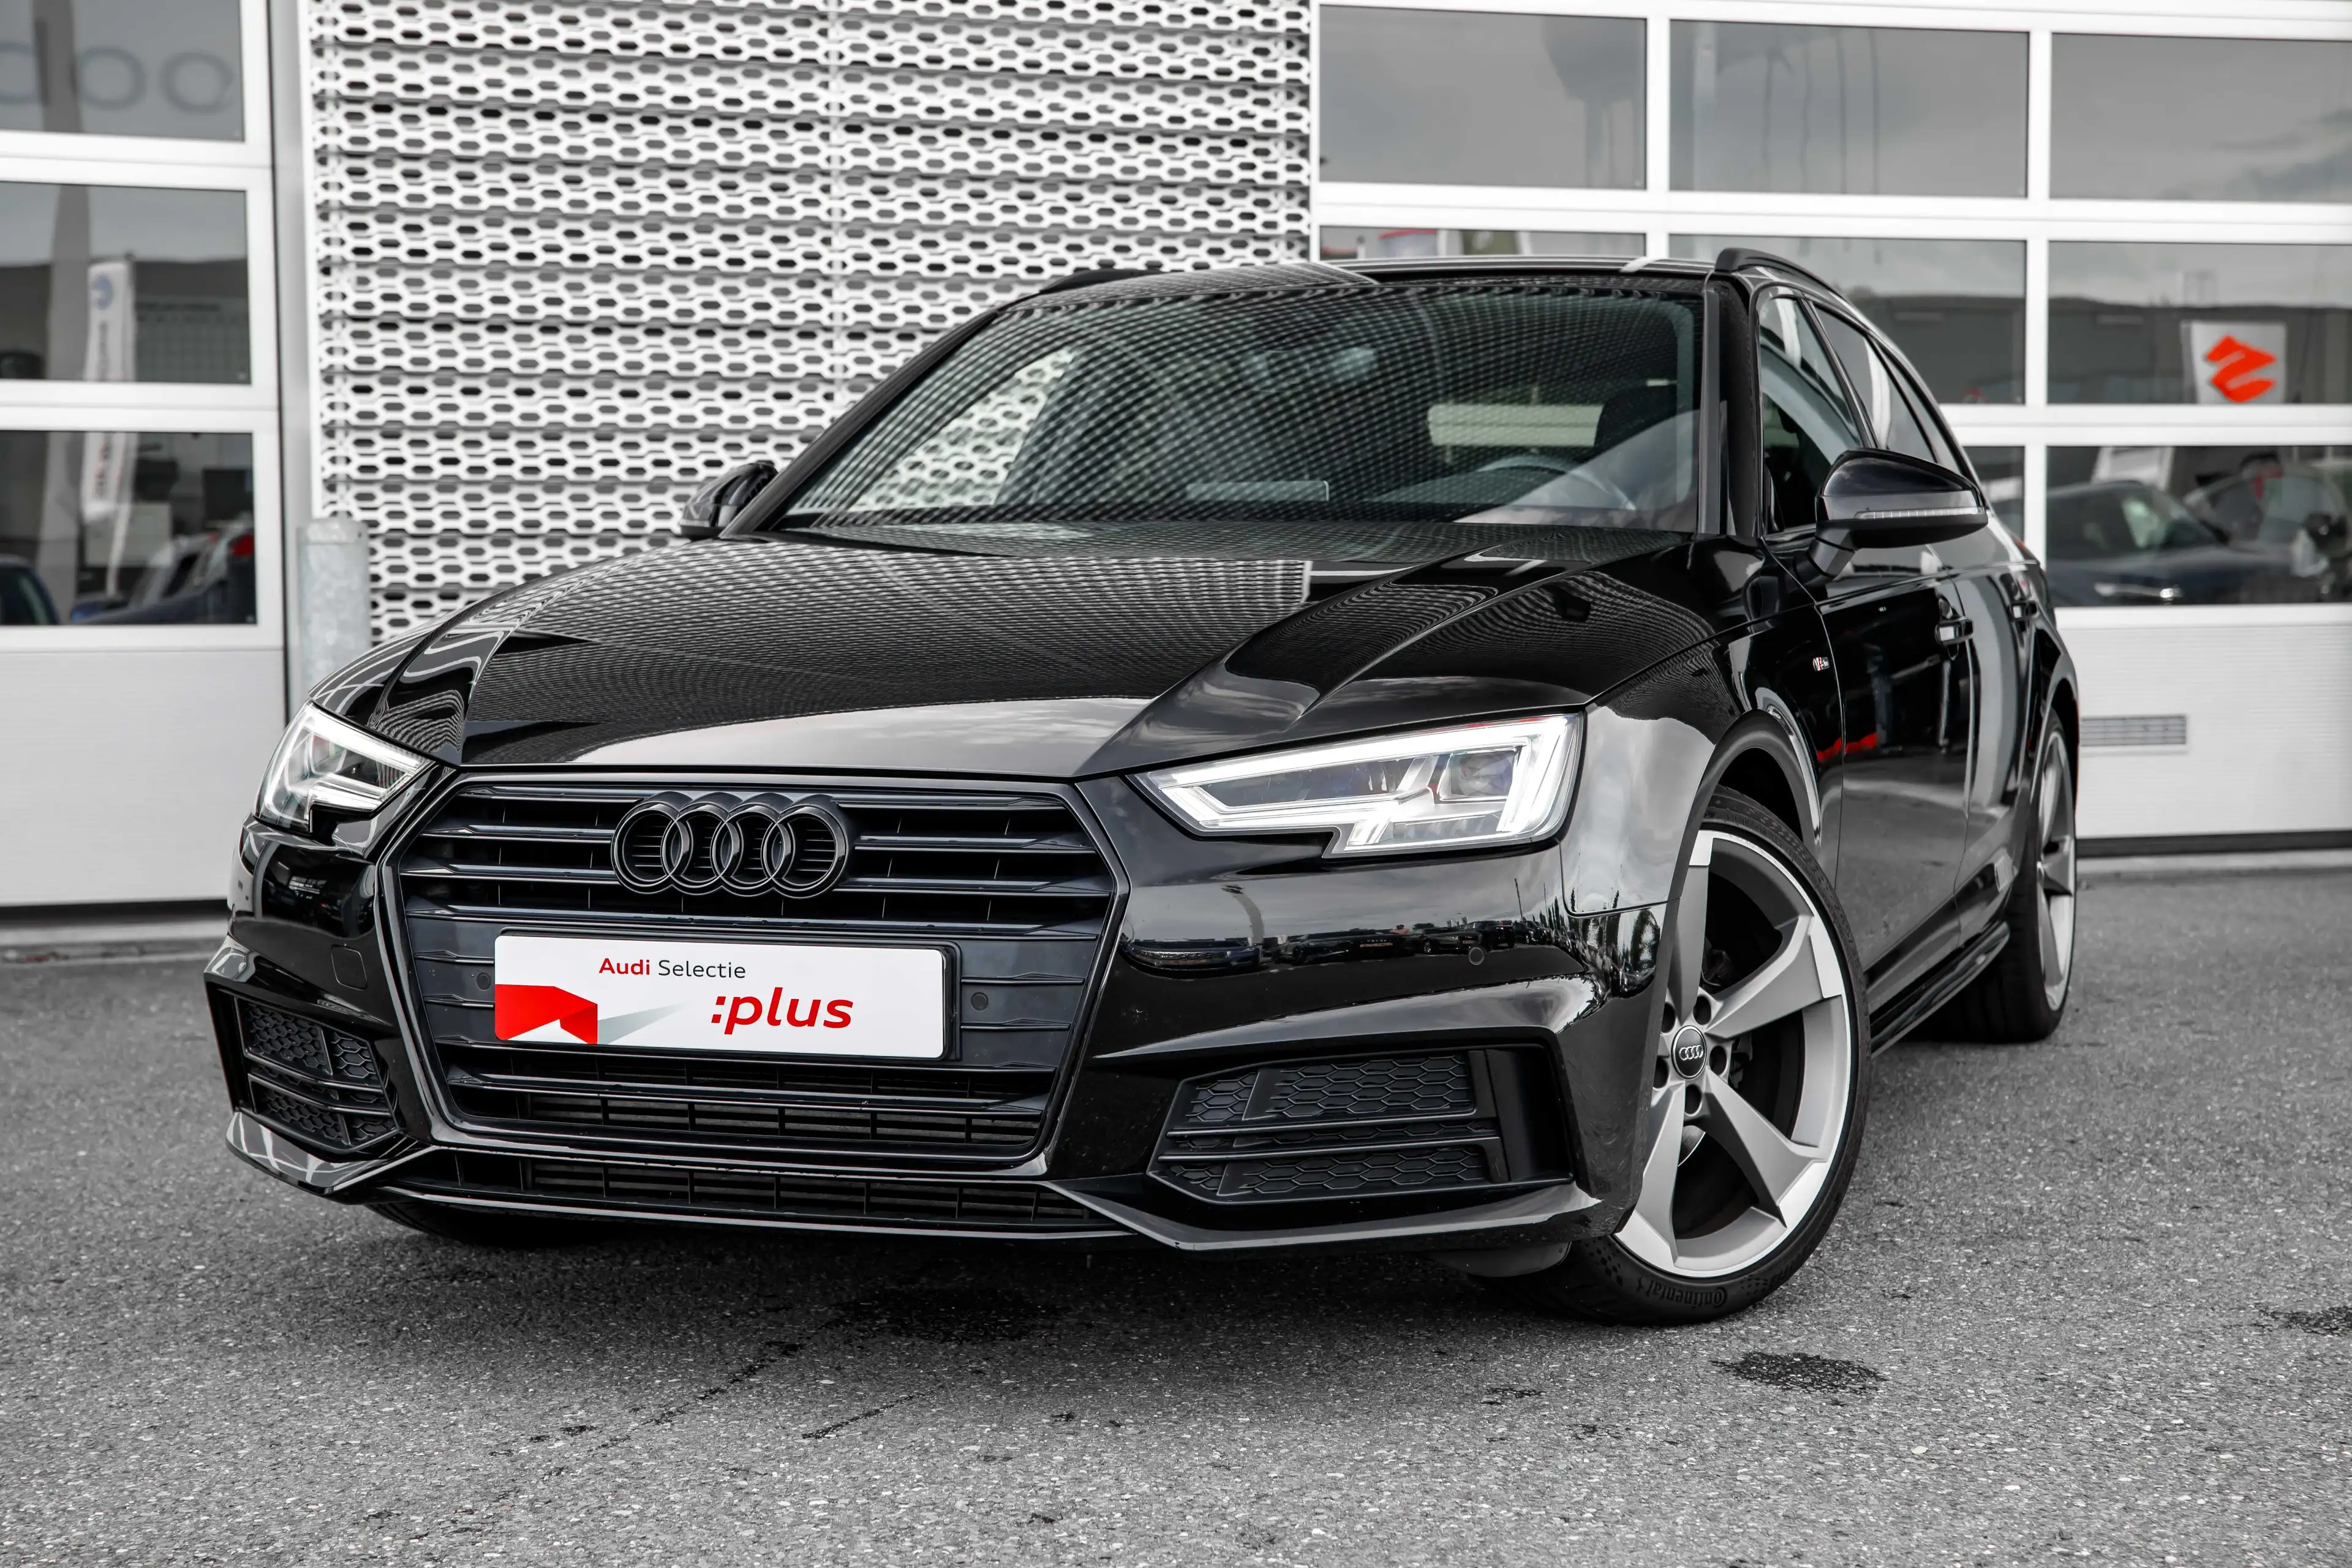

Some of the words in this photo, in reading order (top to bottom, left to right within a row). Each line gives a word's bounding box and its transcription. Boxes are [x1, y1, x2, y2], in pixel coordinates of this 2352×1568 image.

[598, 958, 650, 975] Audi
[658, 960, 745, 978] Selectie
[711, 987, 853, 1035] :plus
[1646, 1280, 1728, 1308] Continental
